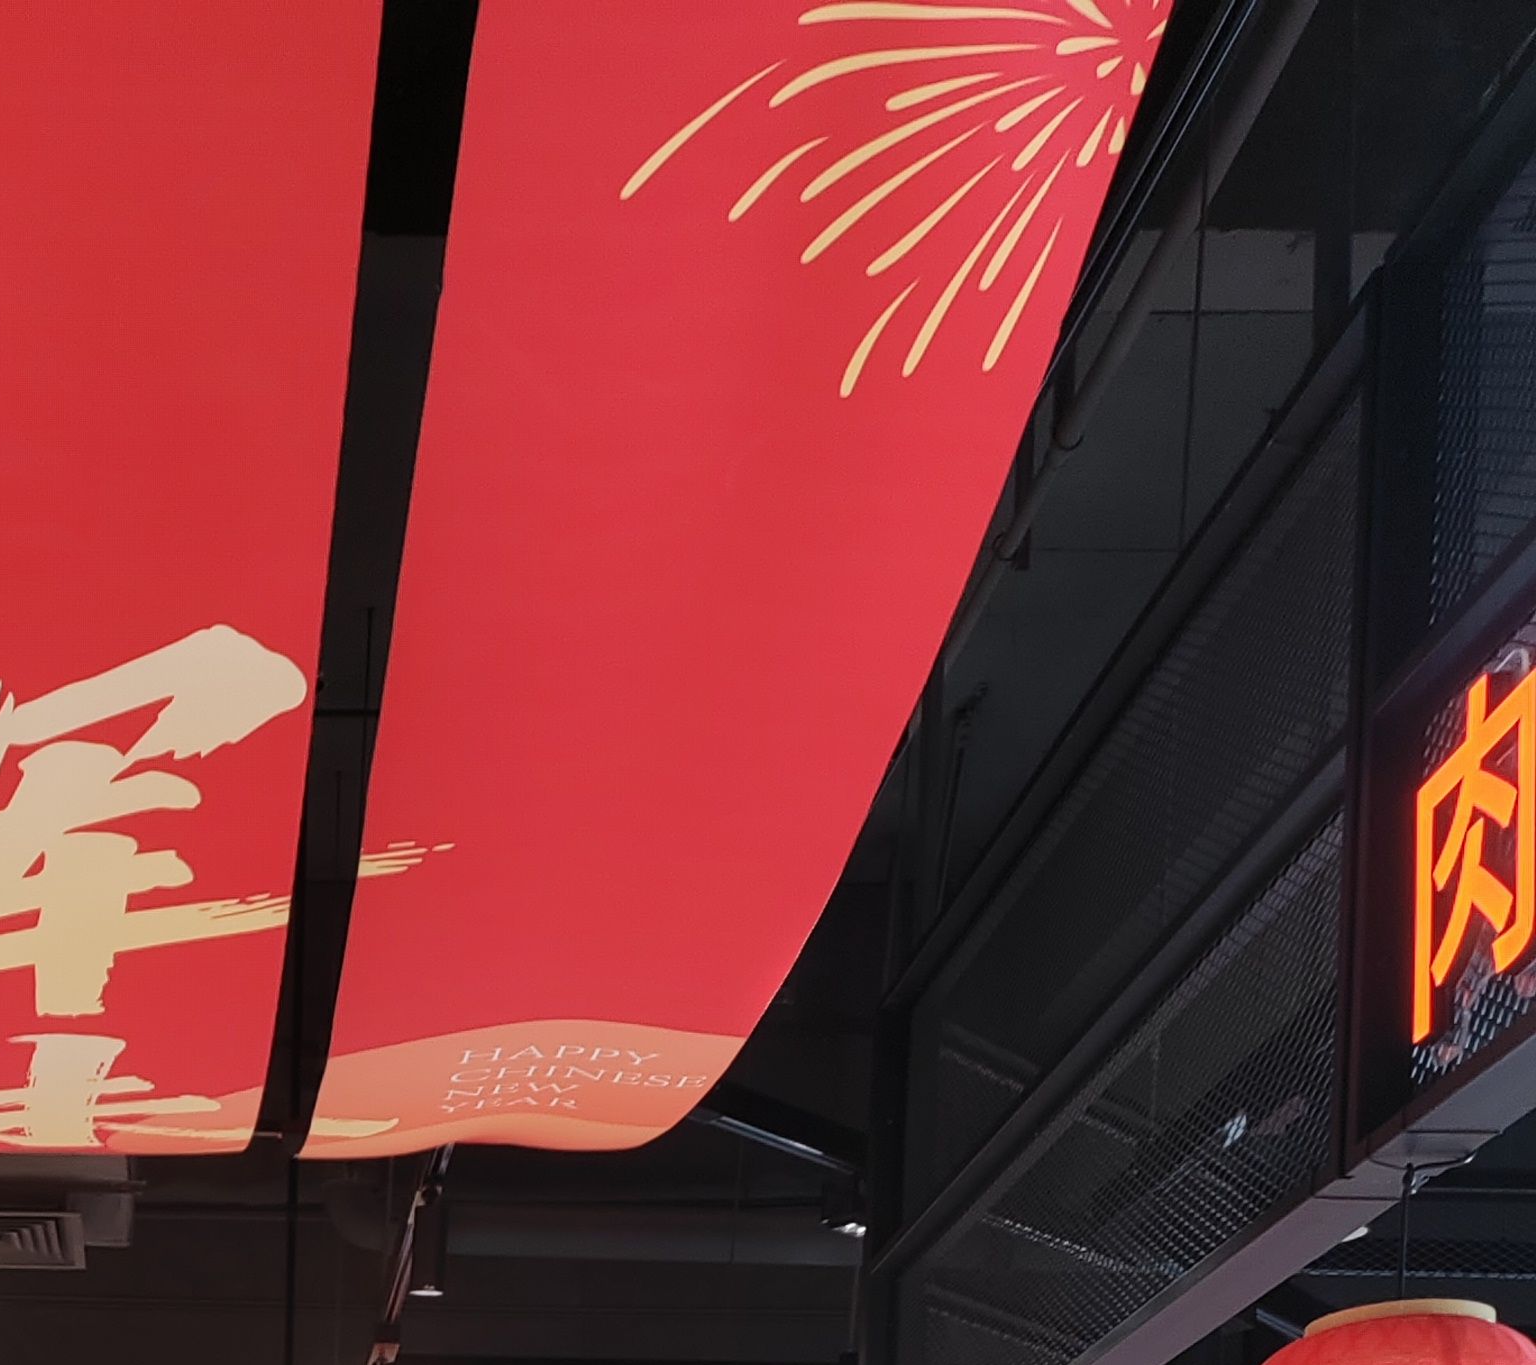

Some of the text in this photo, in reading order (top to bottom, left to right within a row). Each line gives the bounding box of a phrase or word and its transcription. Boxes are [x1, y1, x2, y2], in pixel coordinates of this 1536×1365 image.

[458, 1044, 662, 1067] HAPPY
[449, 1064, 708, 1090] CHINESE
[443, 1082, 580, 1101] NEW
[440, 1096, 578, 1114] YEAR
